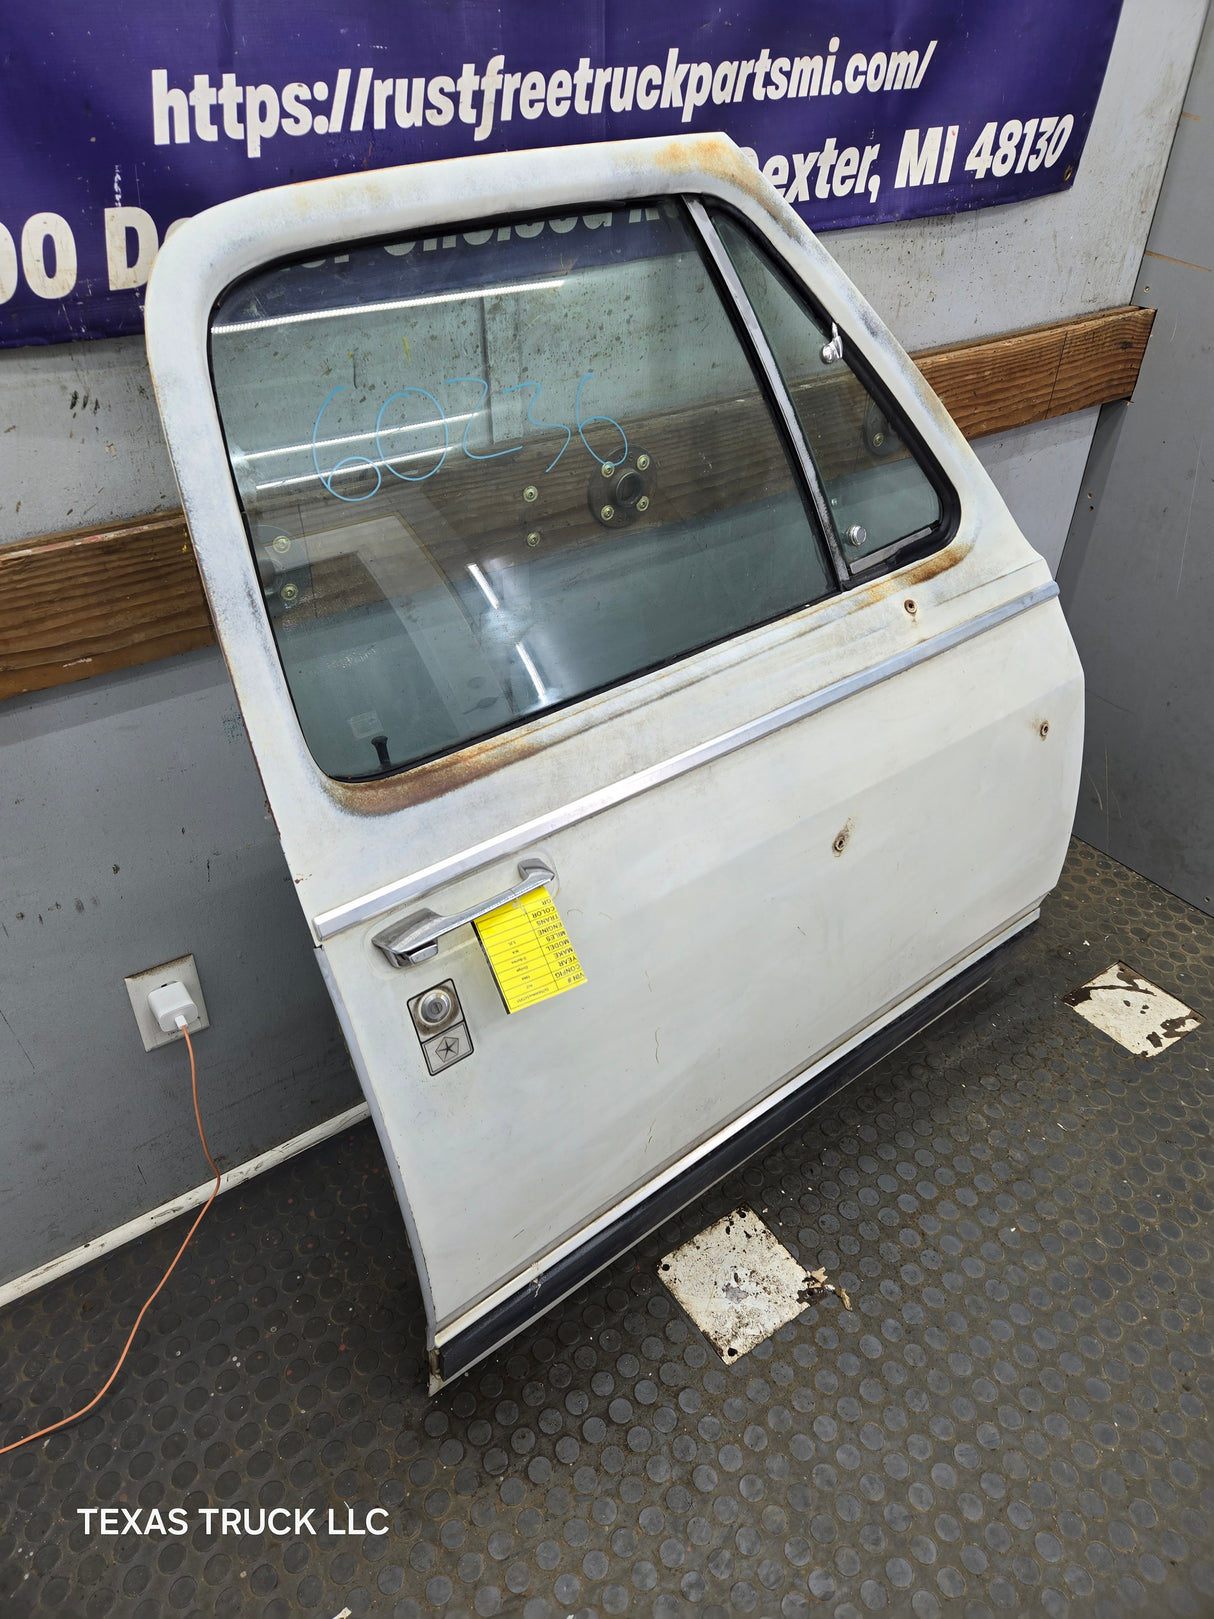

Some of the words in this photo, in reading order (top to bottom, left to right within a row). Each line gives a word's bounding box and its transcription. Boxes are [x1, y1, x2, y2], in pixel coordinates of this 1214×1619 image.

[151, 37, 938, 158] https://rustfreetruckpartsmi.com/
[741, 138, 880, 203] exter,
[895, 125, 960, 189] MI
[964, 114, 1074, 179] 48130
[312, 374, 629, 502] 60236
[532, 906, 555, 918] COLOR
[536, 914, 559, 926] TRANS
[538, 922, 563, 935] ENGINE
[545, 930, 566, 942] MILES
[546, 939, 570, 951] MODEL
[555, 947, 574, 959] MAKE
[558, 955, 577, 967] YEAR
[554, 964, 581, 979] CONFIG
[572, 972, 585, 982] VIN
